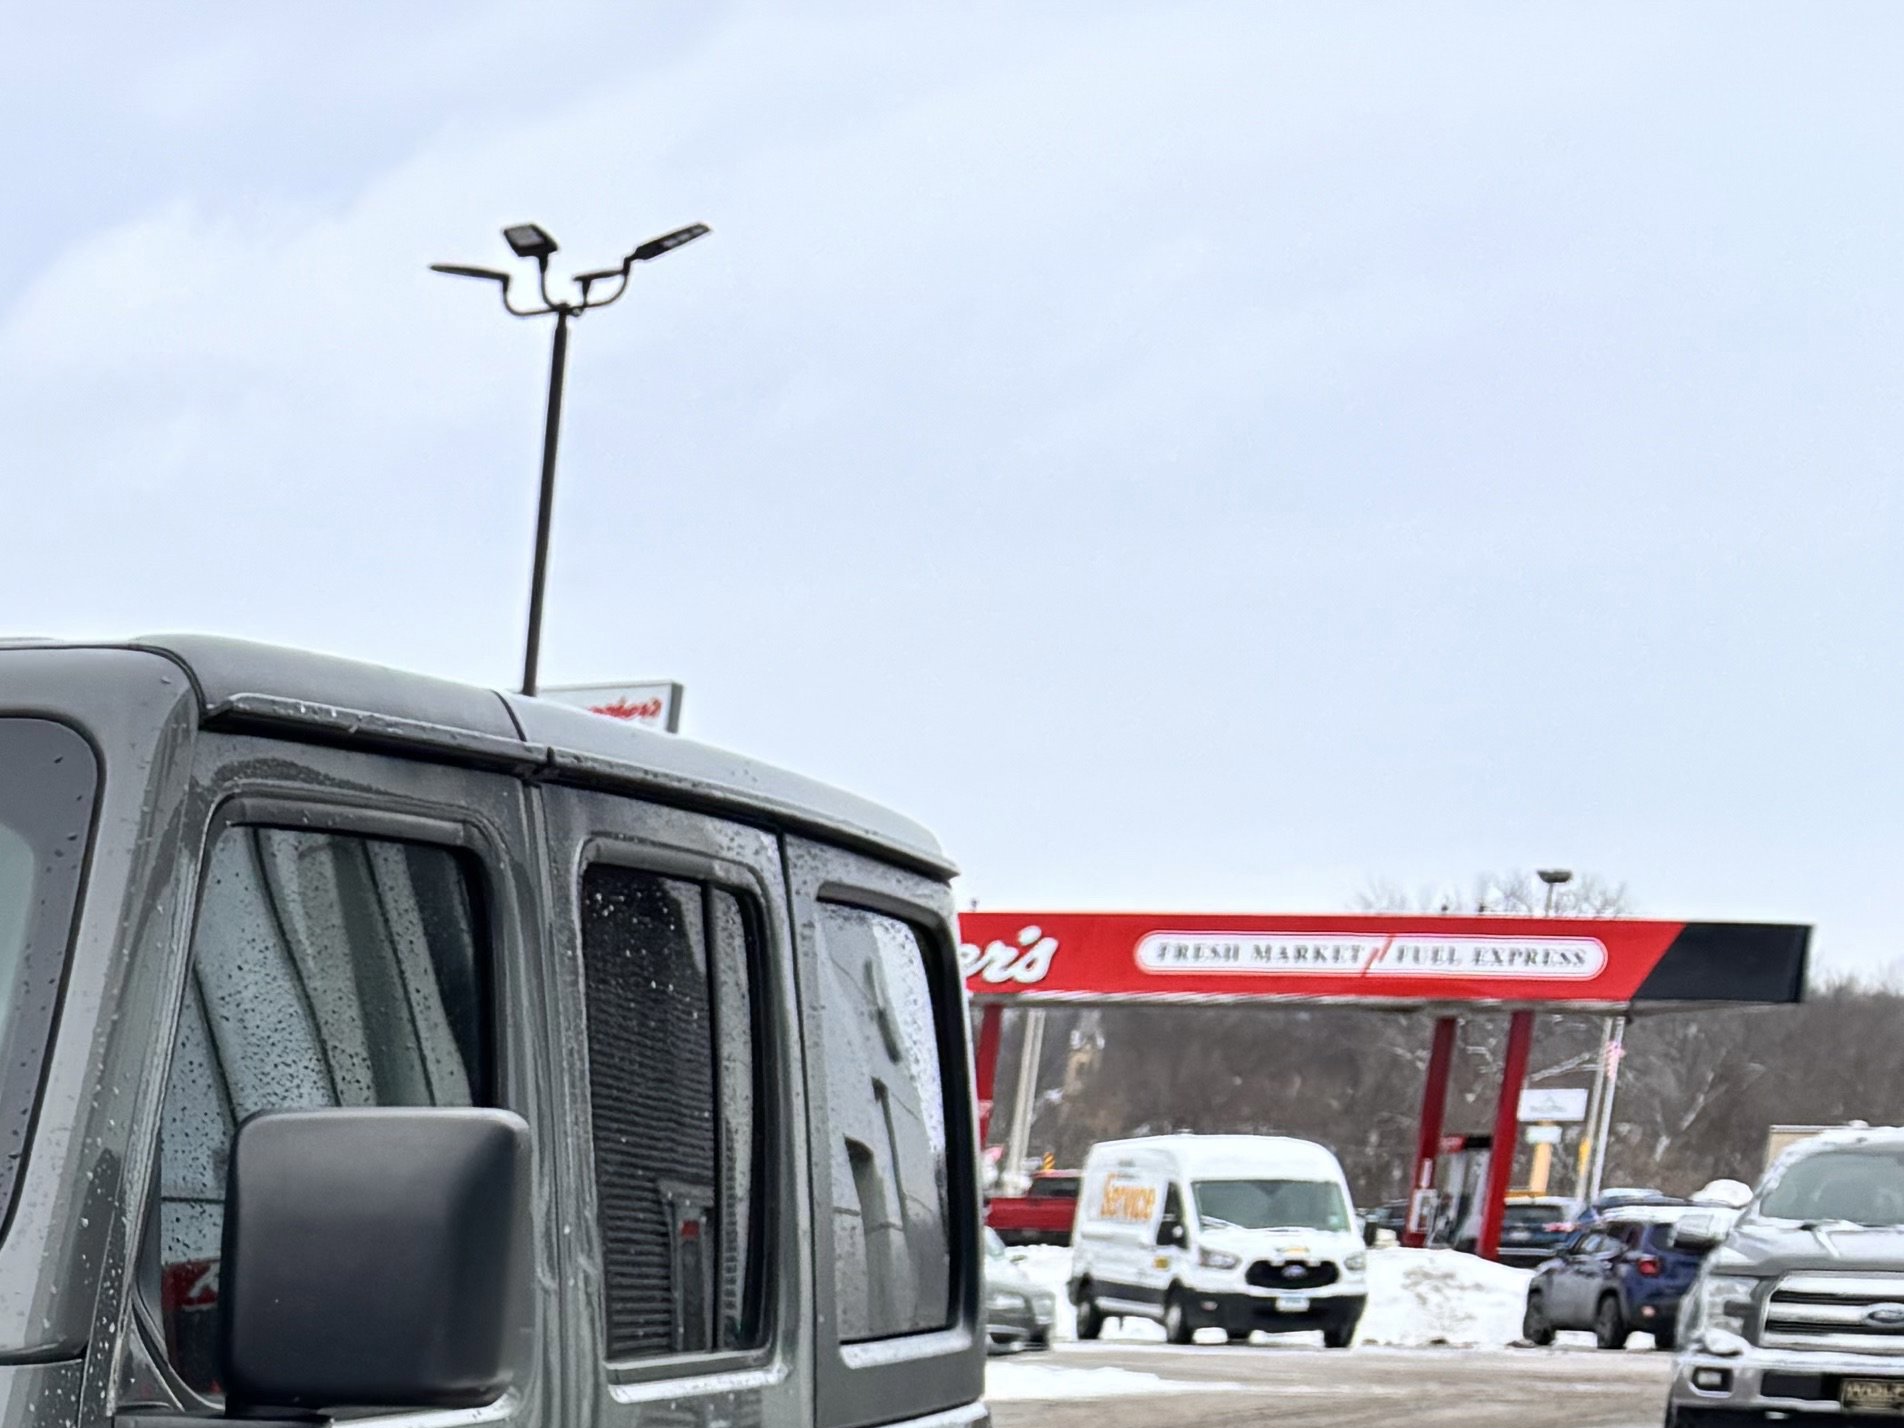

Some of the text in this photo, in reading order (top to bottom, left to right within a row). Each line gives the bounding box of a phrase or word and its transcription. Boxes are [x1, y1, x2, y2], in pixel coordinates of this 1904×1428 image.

[1156, 942, 1587, 968] FRESH MARKET FUEL EXPRESS
